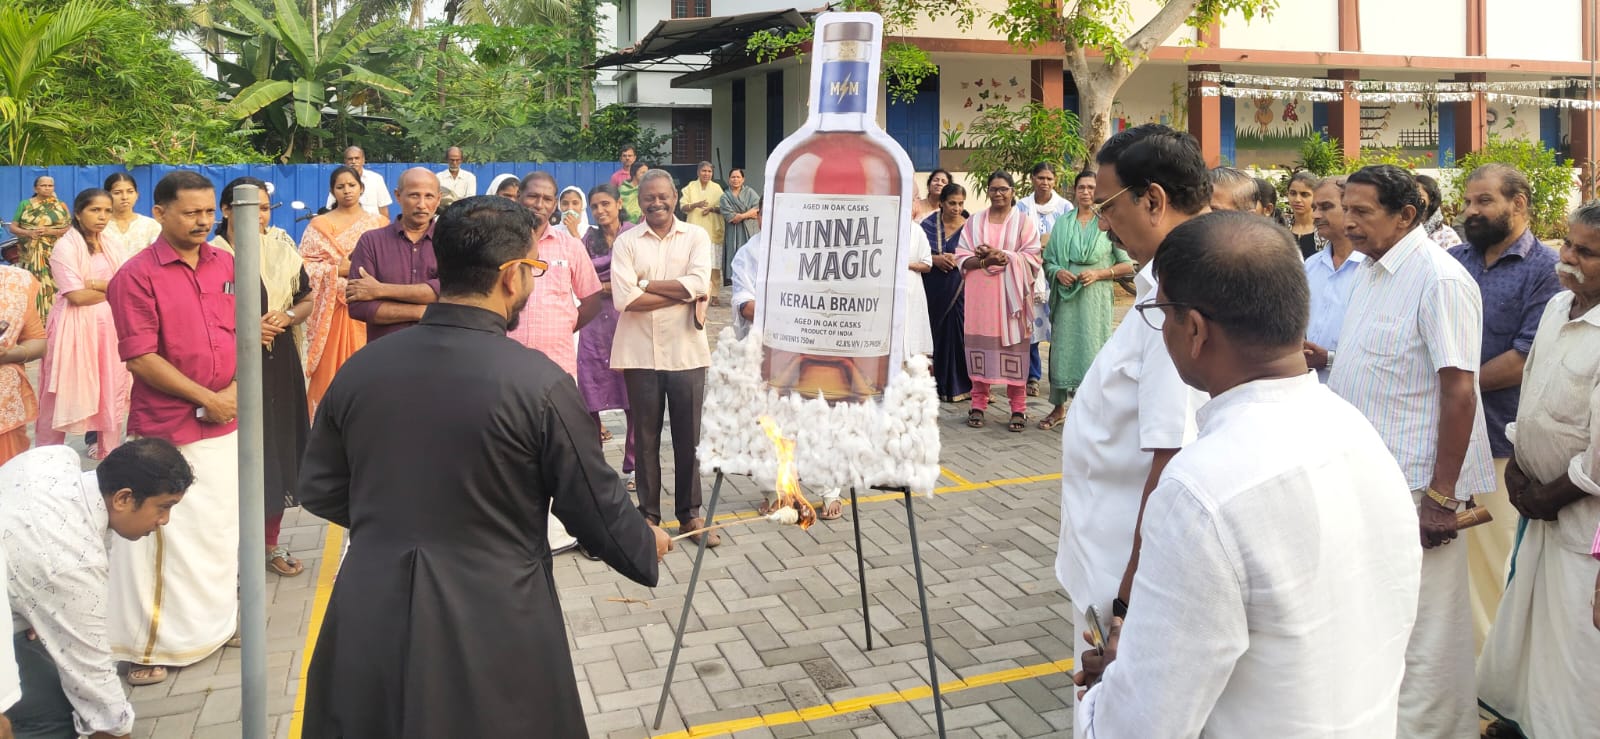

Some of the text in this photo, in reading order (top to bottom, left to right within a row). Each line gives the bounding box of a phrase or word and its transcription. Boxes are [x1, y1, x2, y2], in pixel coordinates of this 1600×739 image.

[822, 203, 829, 211] IN
[847, 204, 870, 212] CASKS
[784, 216, 884, 249] MINNAL
[798, 248, 883, 281] MAGIC
[780, 292, 880, 312] KERALA BRANDY
[794, 317, 812, 325] AGED
[822, 320, 838, 328] OAK
[839, 321, 862, 329] CASKS
[801, 327, 827, 336] PRODUCT
